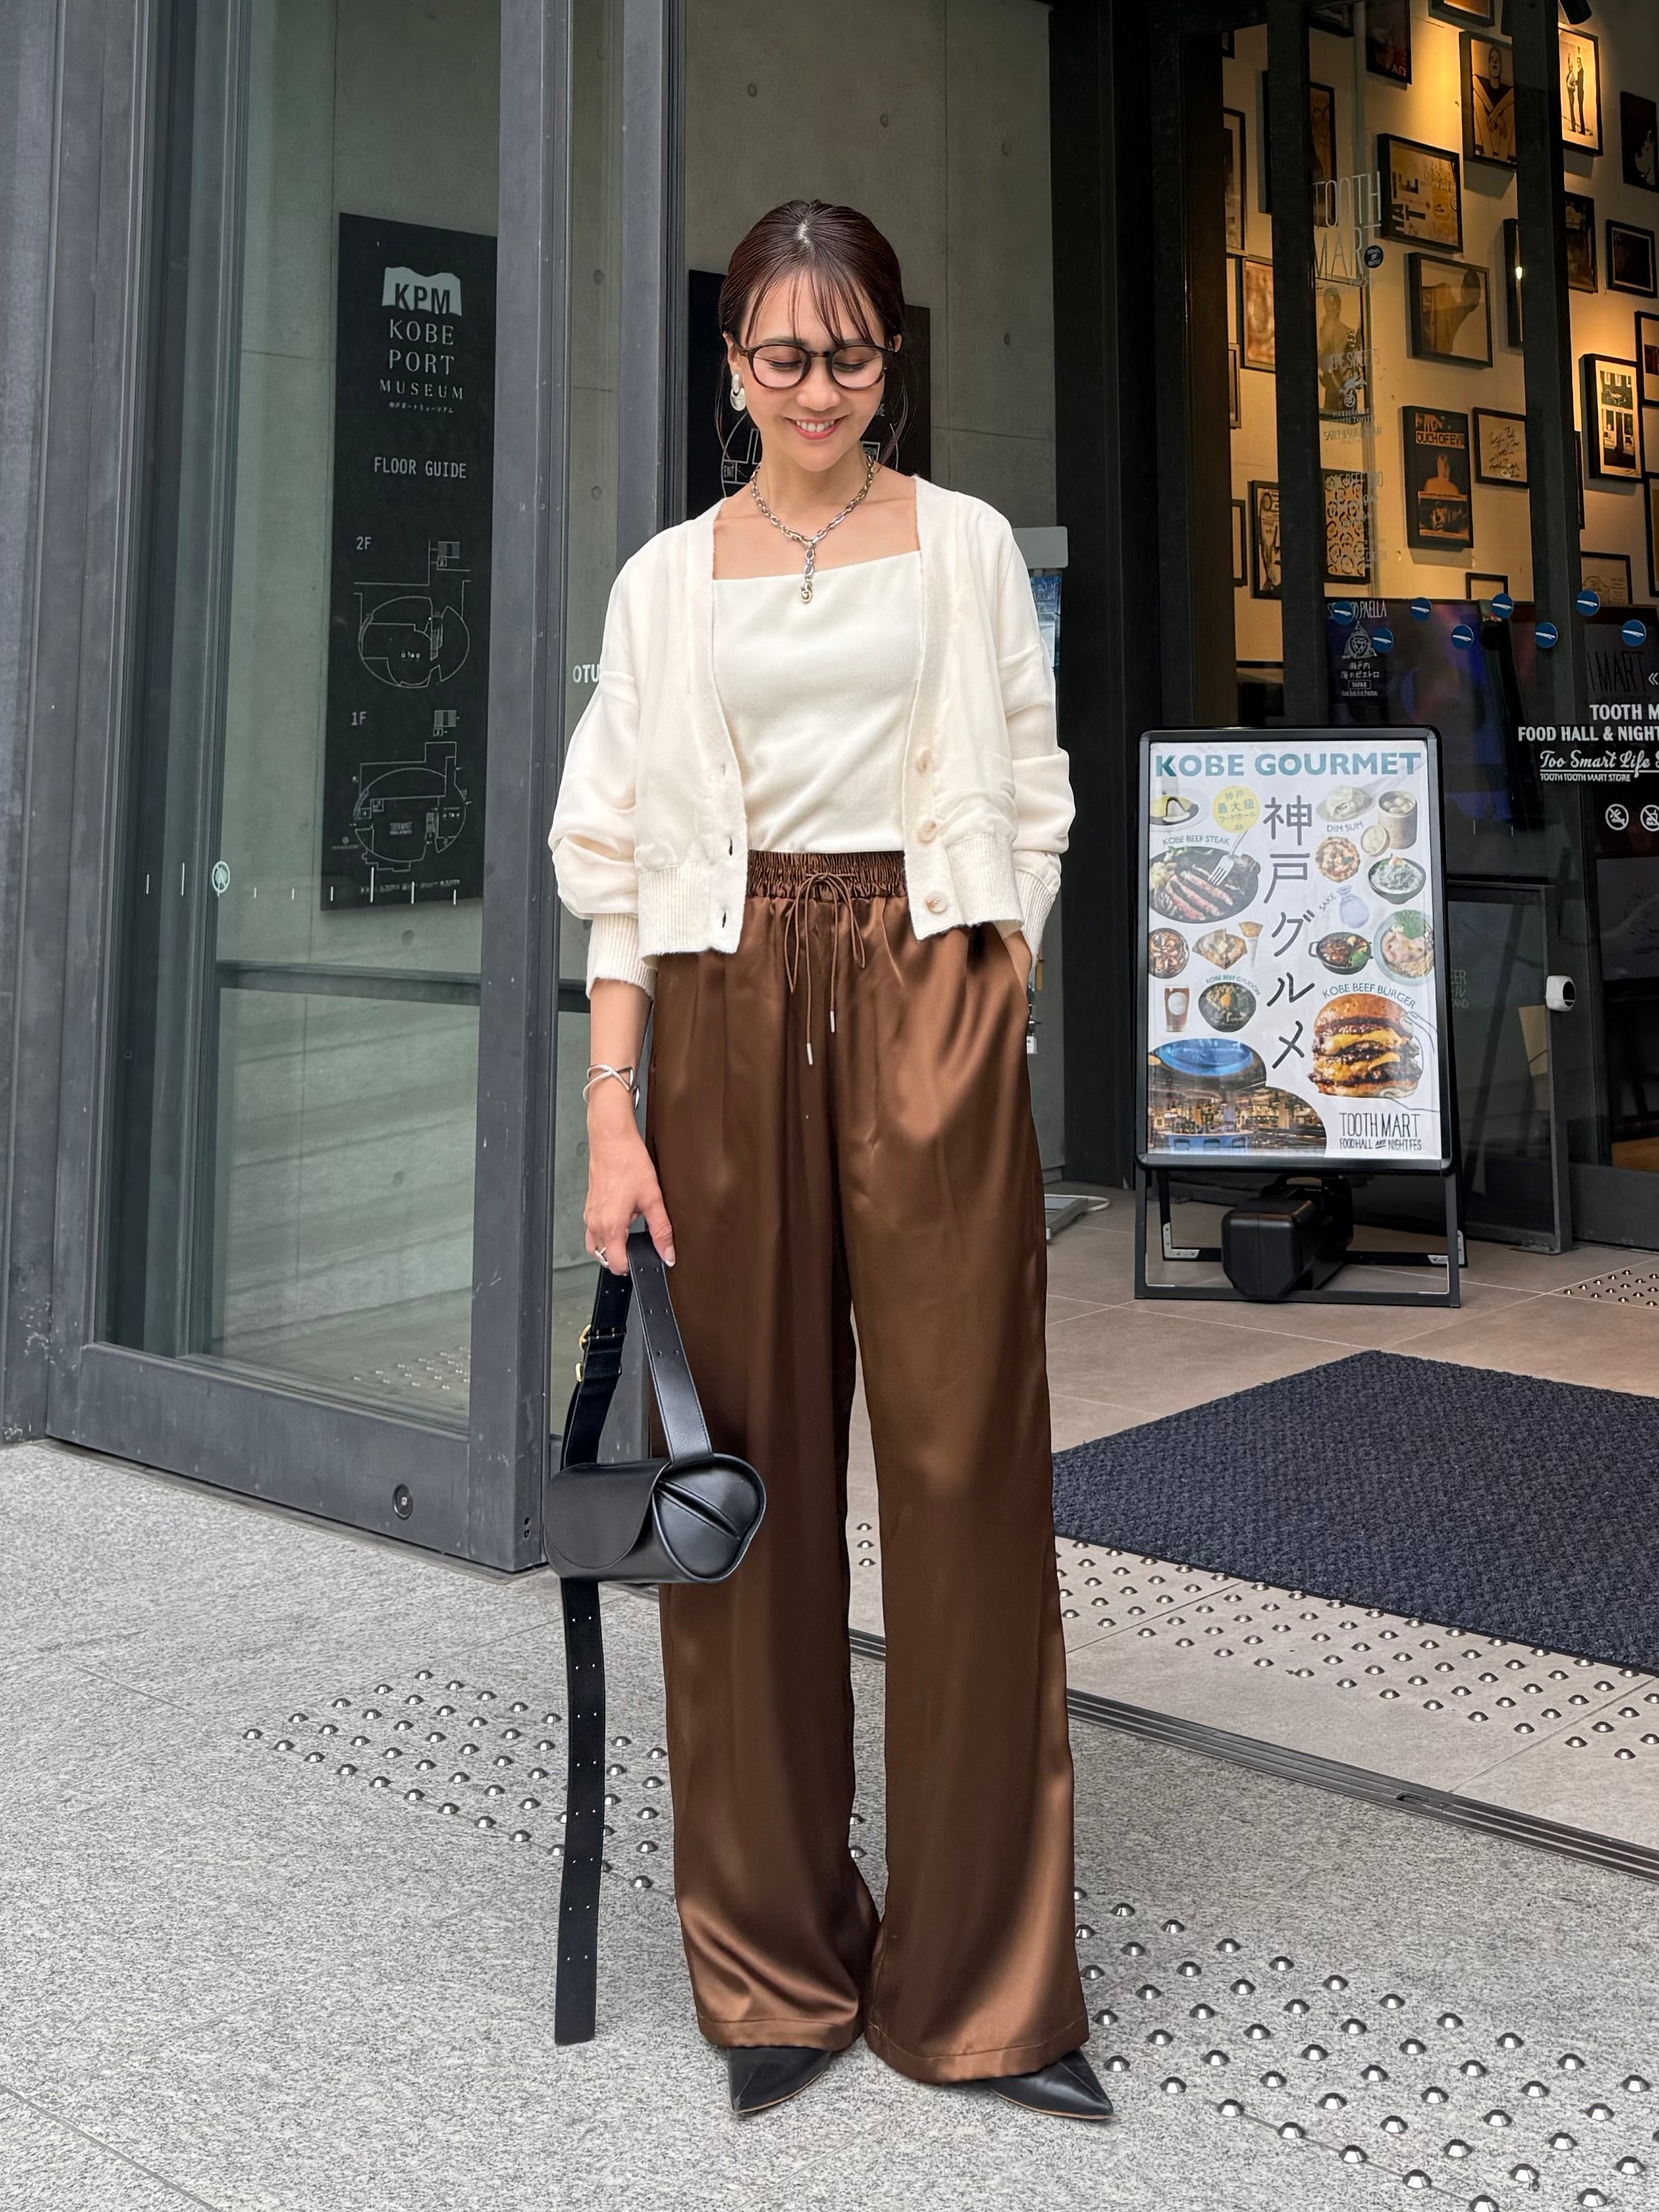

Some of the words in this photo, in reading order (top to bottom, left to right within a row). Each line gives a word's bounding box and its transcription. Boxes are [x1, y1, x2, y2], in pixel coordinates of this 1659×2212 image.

[1313, 171, 1382, 227] TOOTH
[394, 283, 450, 315] KPM
[389, 319, 454, 345] KOBE
[389, 349, 454, 375] PORT
[379, 378, 464, 400] MUSEUM
[374, 457, 416, 475] FLOOR
[425, 461, 467, 478] GUIDE
[355, 536, 372, 550] 2F
[1359, 600, 1387, 619] PAELLA
[351, 711, 366, 726] 1F
[1589, 704, 1643, 720] TOOTH
[1518, 726, 1556, 741] FOOD
[1560, 726, 1599, 741] HALL
[1603, 726, 1613, 741] &
[1156, 754, 1244, 777] KOBE
[1255, 752, 1421, 777] GOURMET
[1539, 750, 1567, 768] Too
[1570, 749, 1617, 768] Smart
[1620, 749, 1651, 779] Life
[1540, 773, 1563, 781] TOOTH
[1563, 773, 1586, 781] TOOTH
[1587, 773, 1607, 781] MART
[1608, 773, 1631, 782] STORE
[1326, 824, 1343, 833] DIM
[1345, 821, 1364, 832] SUM
[1162, 836, 1185, 846] KOBE
[1185, 834, 1205, 843] BEEF
[1205, 835, 1230, 845] STEAK
[1319, 891, 1336, 912] SAKE
[1262, 794, 1315, 1069] 神戸グルメ
[1450, 969, 1467, 985] EER
[1322, 983, 1351, 999] KOBE
[1353, 982, 1376, 992] BEEF
[1377, 985, 1416, 1010] BURGER
[1339, 1112, 1378, 1137] TOOTH
[1381, 1113, 1421, 1138] MART
